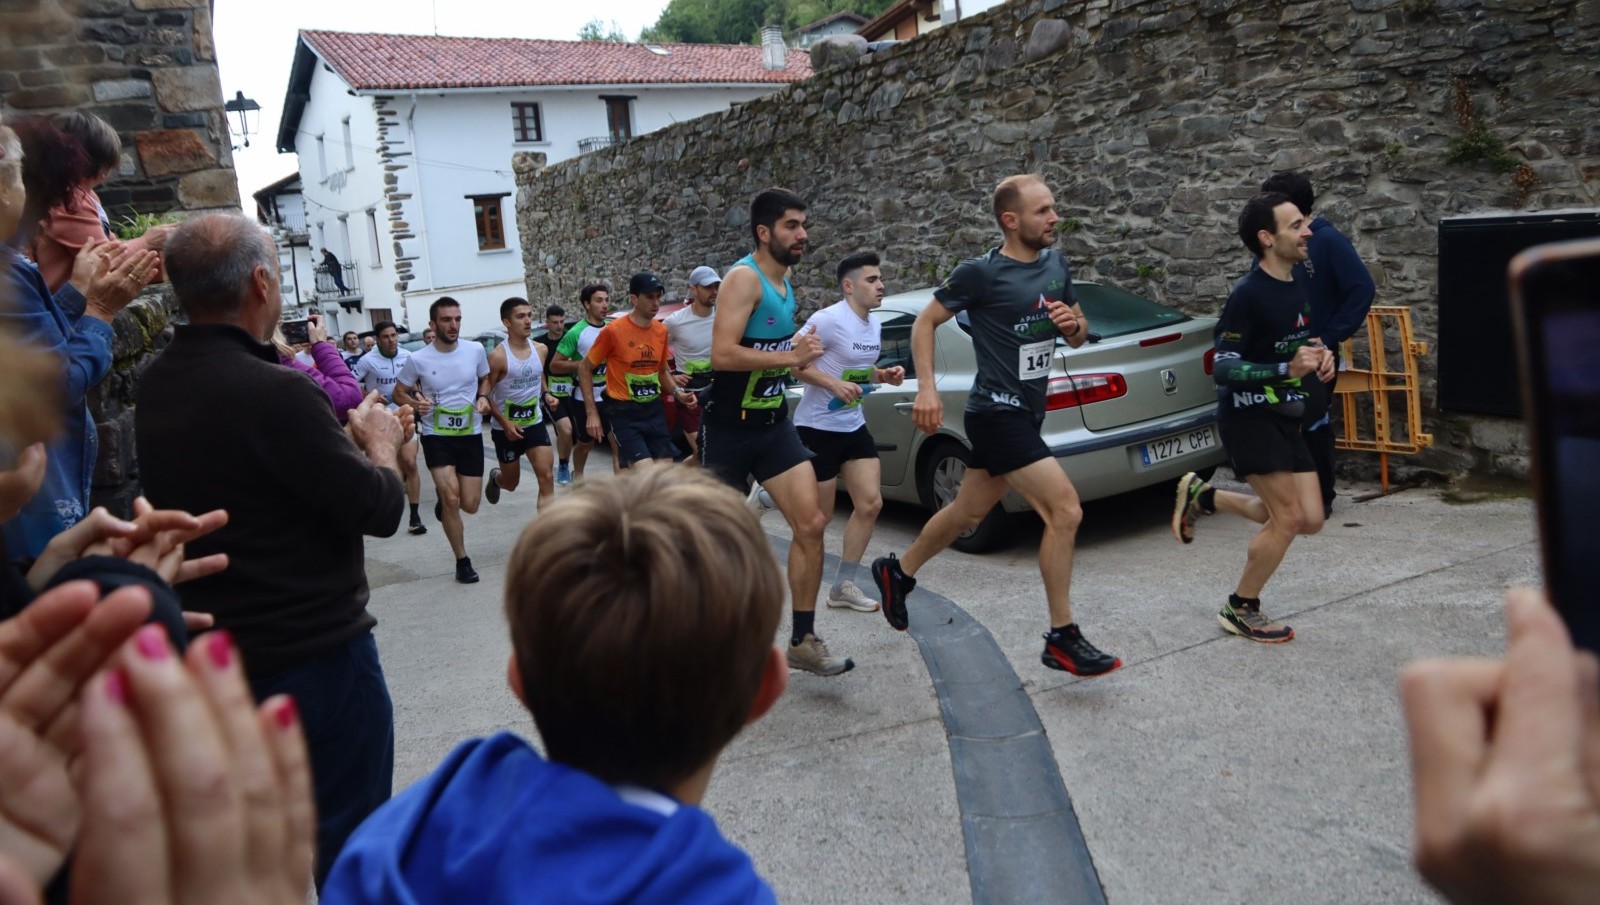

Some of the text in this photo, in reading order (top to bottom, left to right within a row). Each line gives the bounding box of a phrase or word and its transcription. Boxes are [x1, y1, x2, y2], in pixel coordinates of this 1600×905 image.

[1027, 352, 1050, 371] 147
[556, 384, 567, 392] 82
[447, 416, 463, 428] 30
[1151, 429, 1211, 461] 1272 CPF
